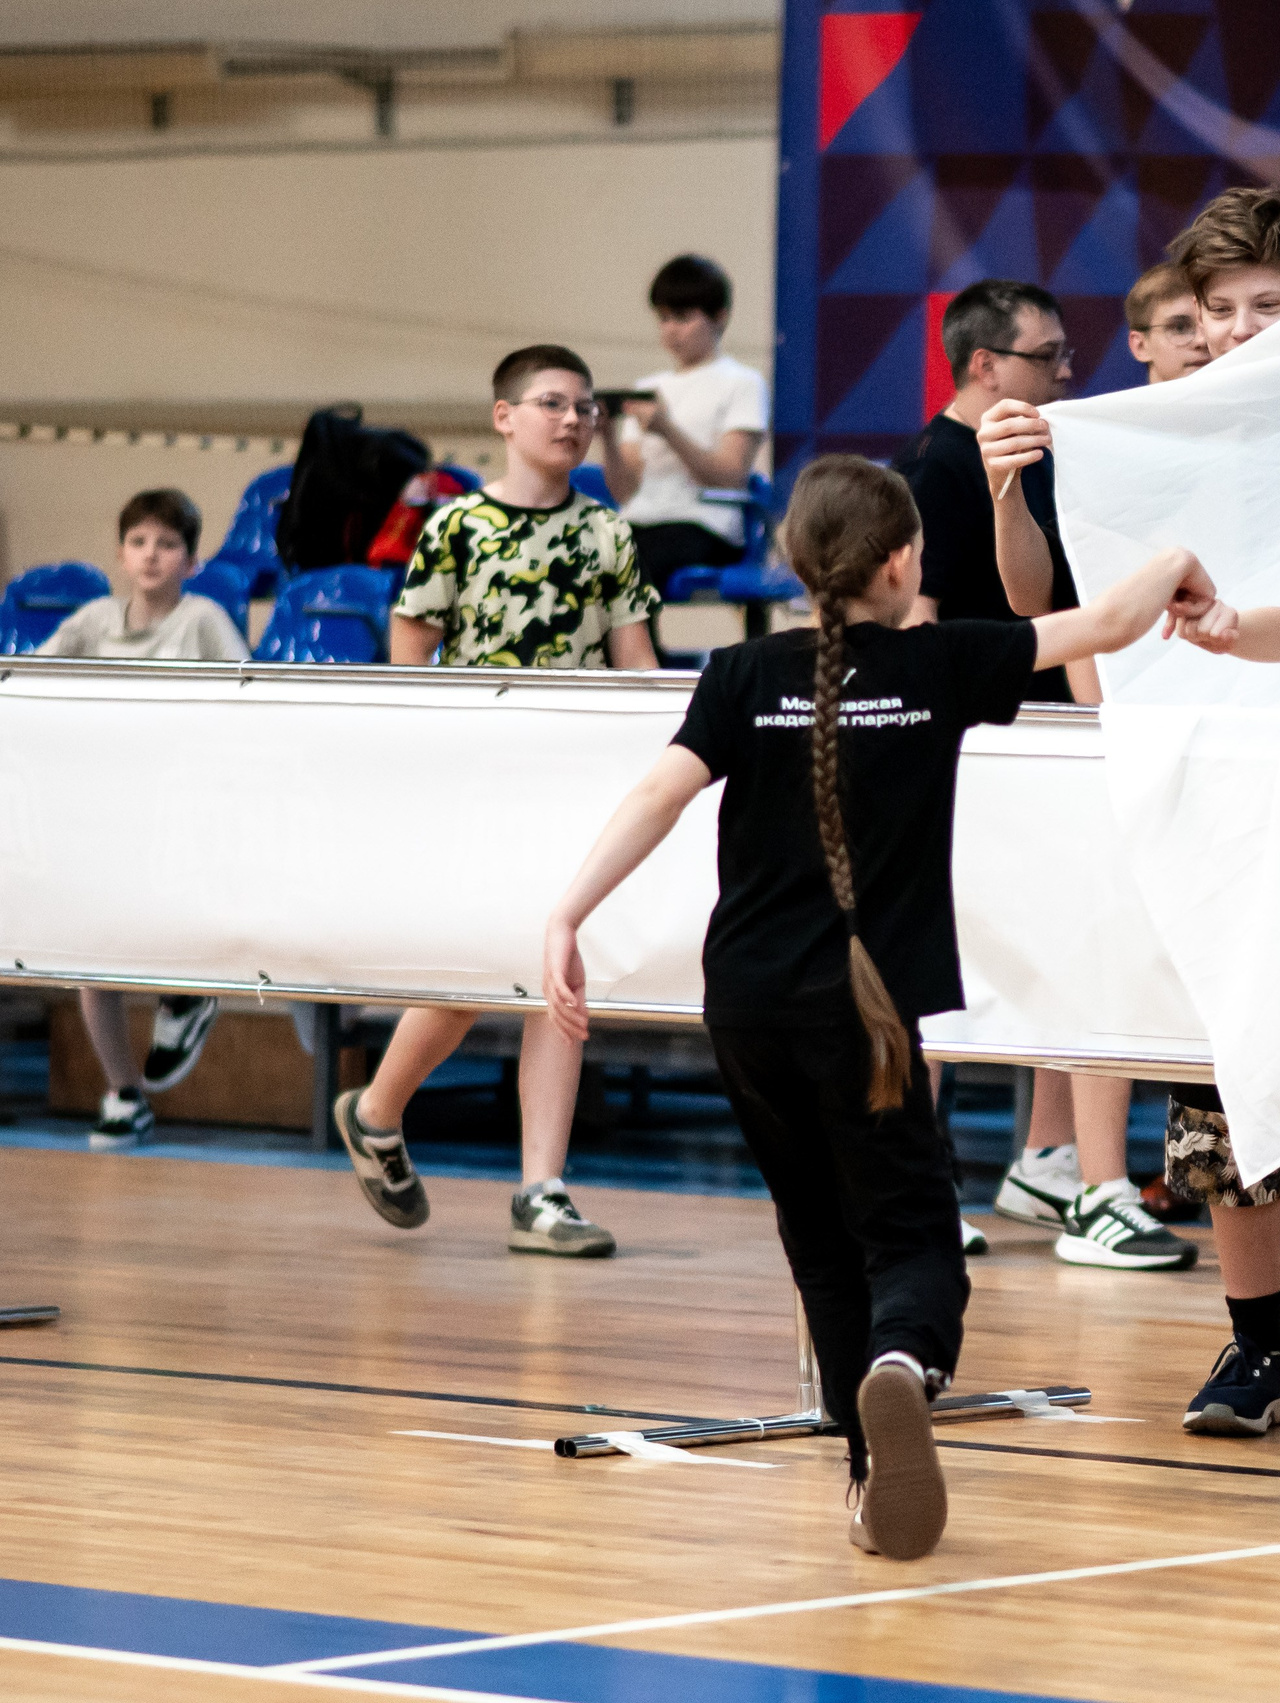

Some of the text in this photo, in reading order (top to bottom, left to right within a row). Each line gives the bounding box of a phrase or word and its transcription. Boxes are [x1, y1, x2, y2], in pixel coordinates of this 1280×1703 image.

[781, 696, 902, 711] Мовская
[755, 709, 932, 728] акадея паркура
